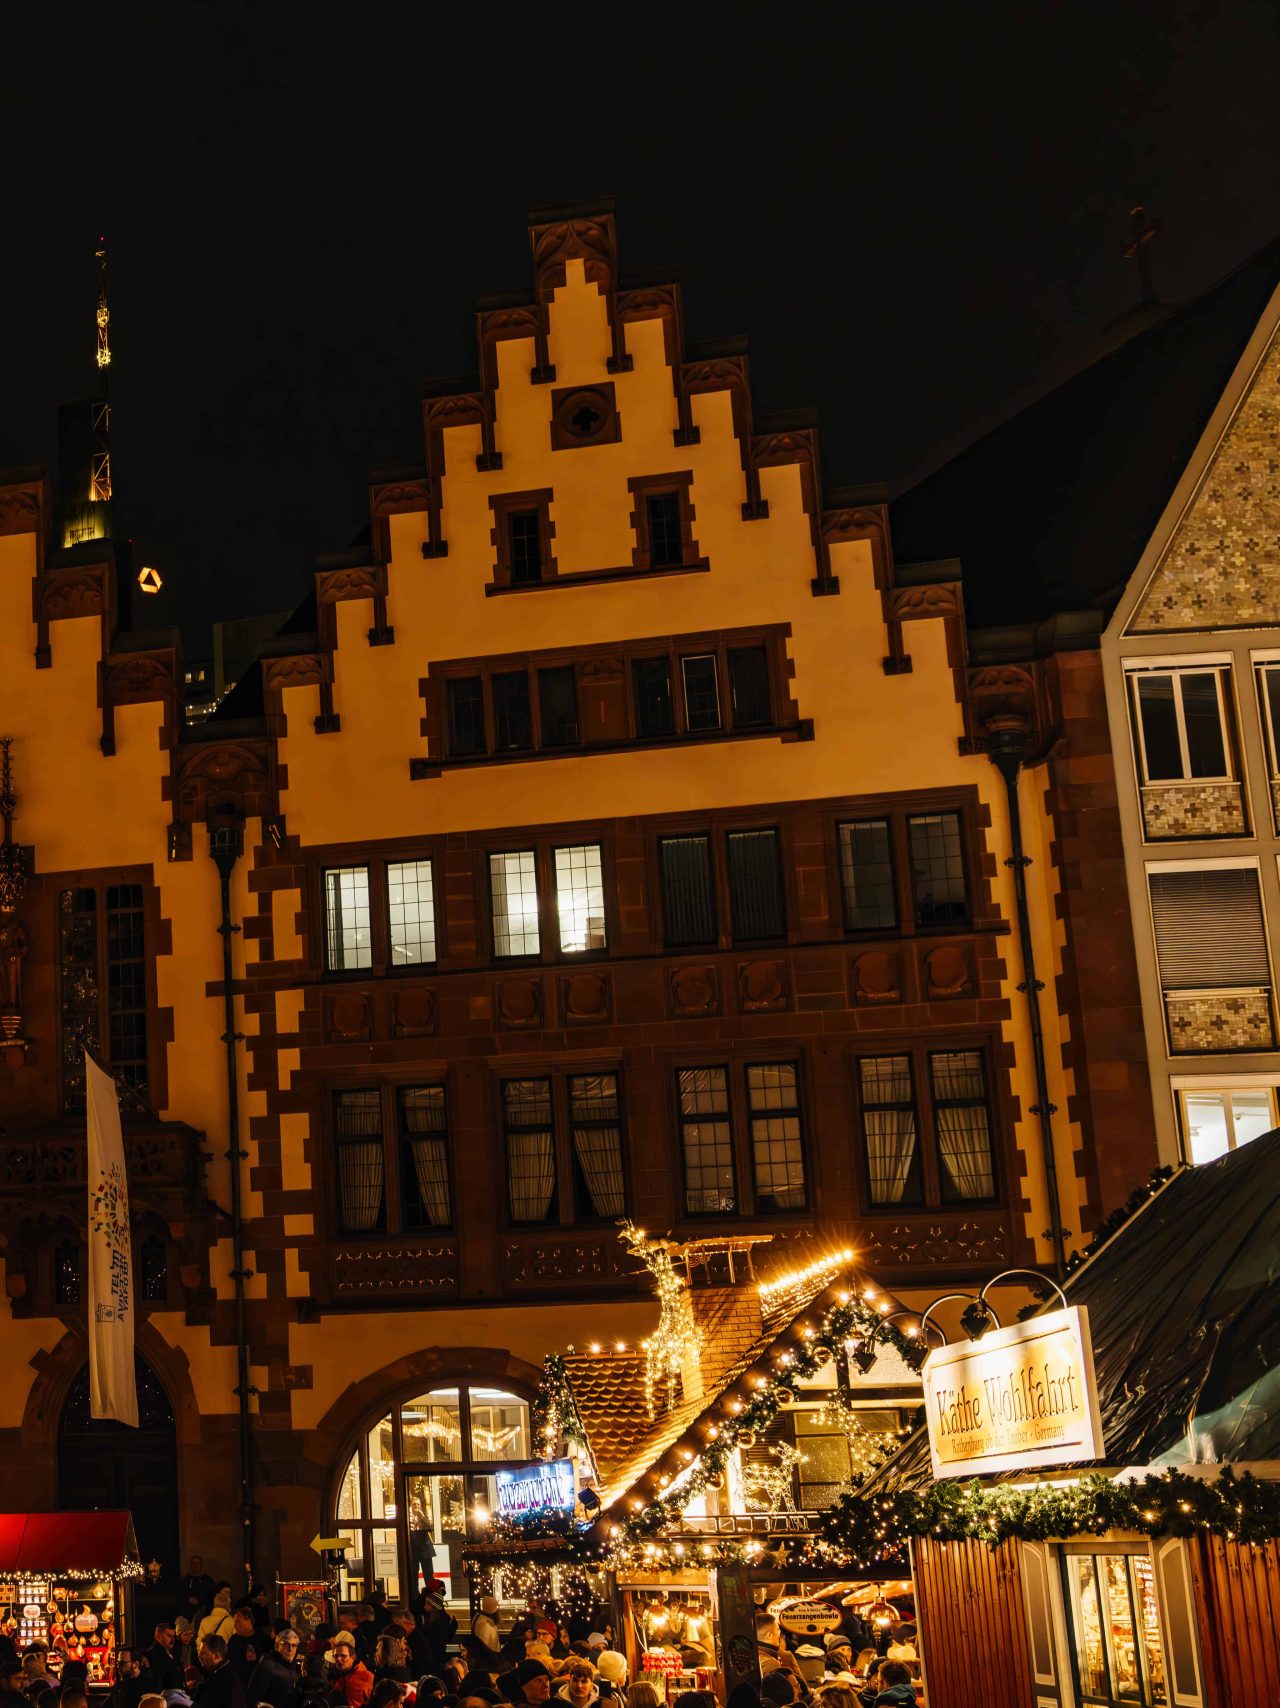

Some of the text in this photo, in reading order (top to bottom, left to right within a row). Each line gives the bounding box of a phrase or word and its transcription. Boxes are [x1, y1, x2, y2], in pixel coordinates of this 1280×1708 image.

[111, 1272, 120, 1296] TEL
[936, 1363, 1079, 1436] Käthe Wohlfahrt
[951, 1437, 985, 1454] Rothenburg
[1034, 1422, 1065, 1441] Germany
[782, 1612, 839, 1621] Feuerzangenbowle
